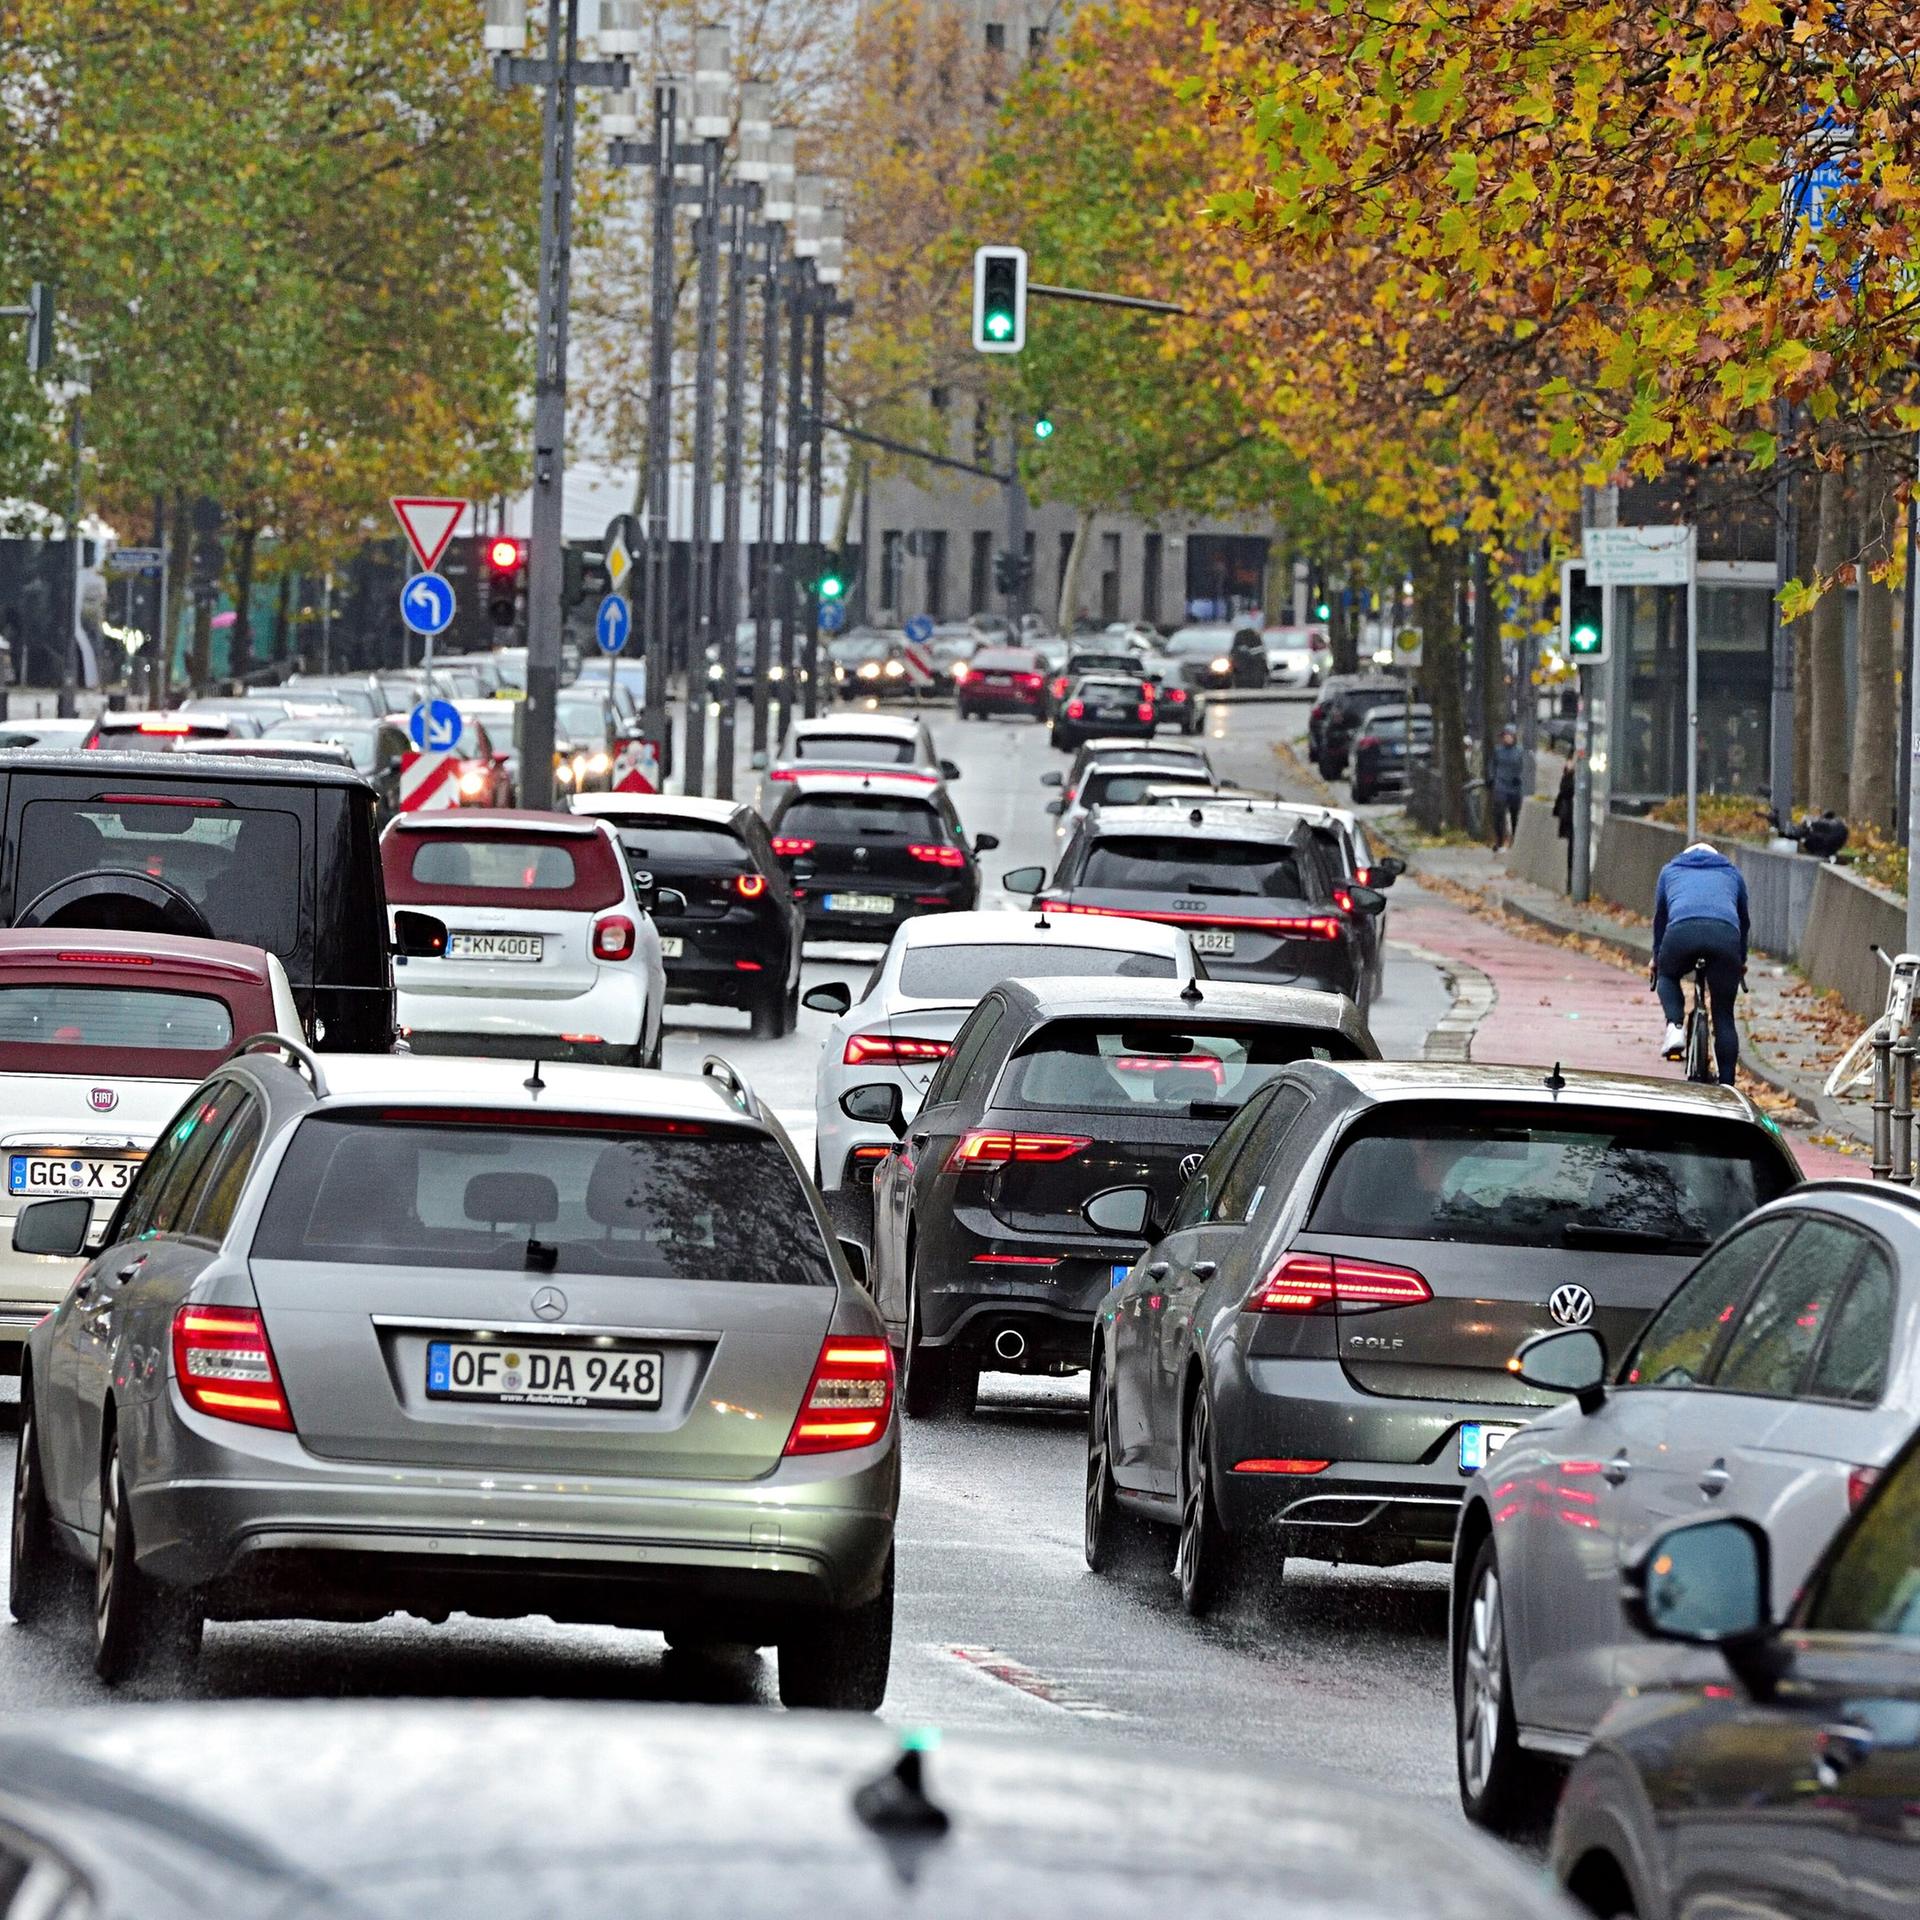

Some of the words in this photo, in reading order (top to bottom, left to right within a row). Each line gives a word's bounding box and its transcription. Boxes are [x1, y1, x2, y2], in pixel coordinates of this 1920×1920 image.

[452, 937, 462, 952] F
[473, 937, 495, 953] KN
[94, 1091, 113, 1104] FIAT
[30, 1161, 66, 1186] GG
[87, 1163, 104, 1188] X
[1349, 1336, 1404, 1350] GOLF
[434, 1373, 445, 1384] D
[452, 1350, 501, 1387] OF
[527, 1353, 575, 1391] DA
[586, 1357, 656, 1396] 948
